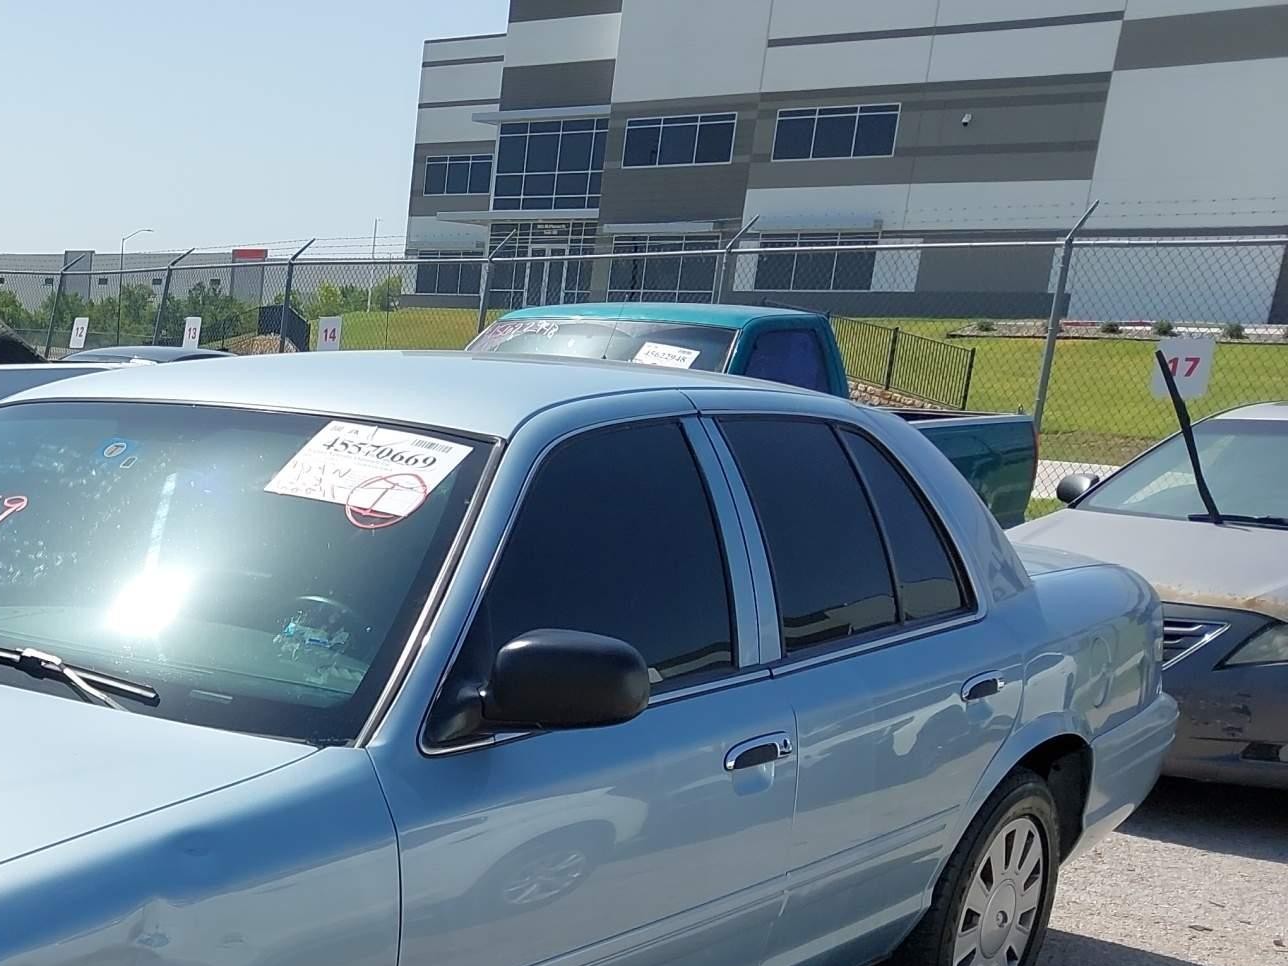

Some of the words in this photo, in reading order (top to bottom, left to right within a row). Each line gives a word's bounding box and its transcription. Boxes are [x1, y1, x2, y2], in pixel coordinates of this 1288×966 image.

[75, 326, 85, 338] 12
[187, 327, 197, 340] 13
[323, 327, 337, 342] 14
[1168, 357, 1200, 377] 17
[322, 436, 437, 468] 45570669
